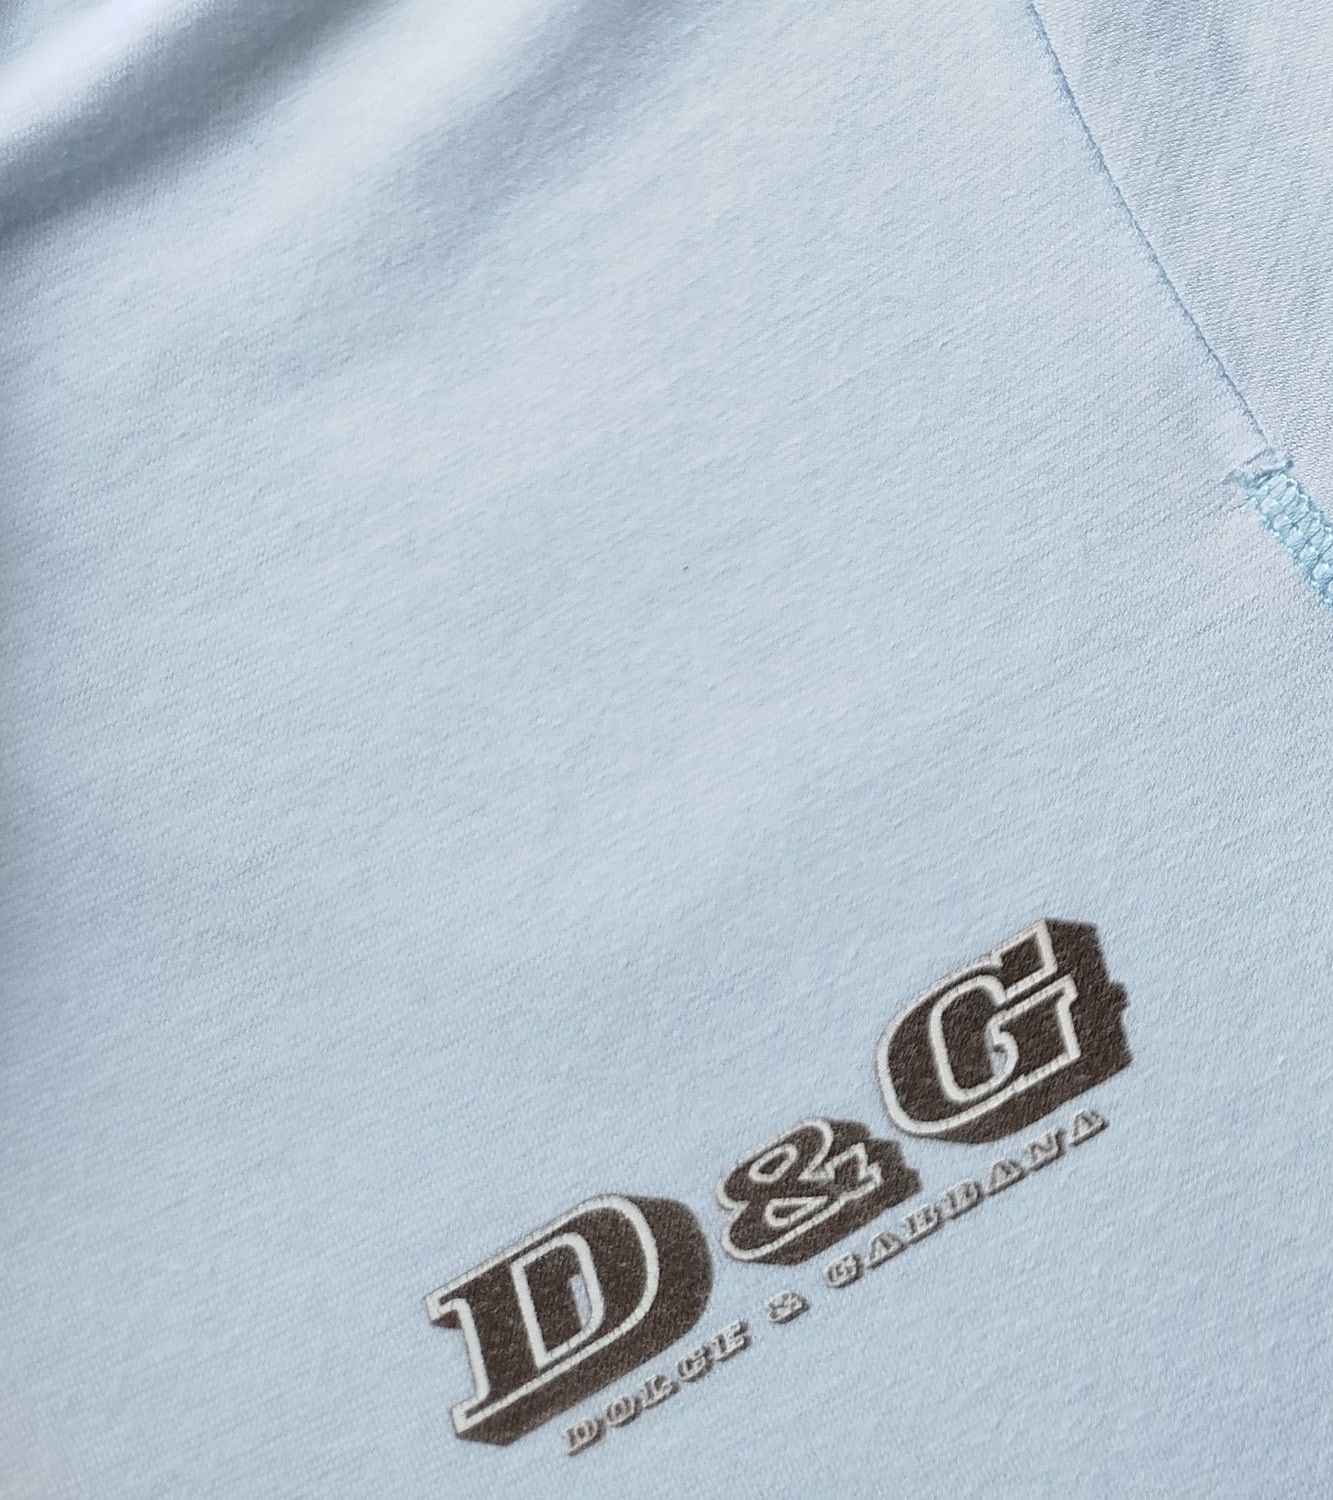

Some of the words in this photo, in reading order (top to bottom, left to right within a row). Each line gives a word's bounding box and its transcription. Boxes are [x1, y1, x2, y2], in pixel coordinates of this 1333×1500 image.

[565, 1320, 752, 1456] DOLCE
[764, 1291, 808, 1326] &
[822, 1107, 1110, 1290] GABBANA
